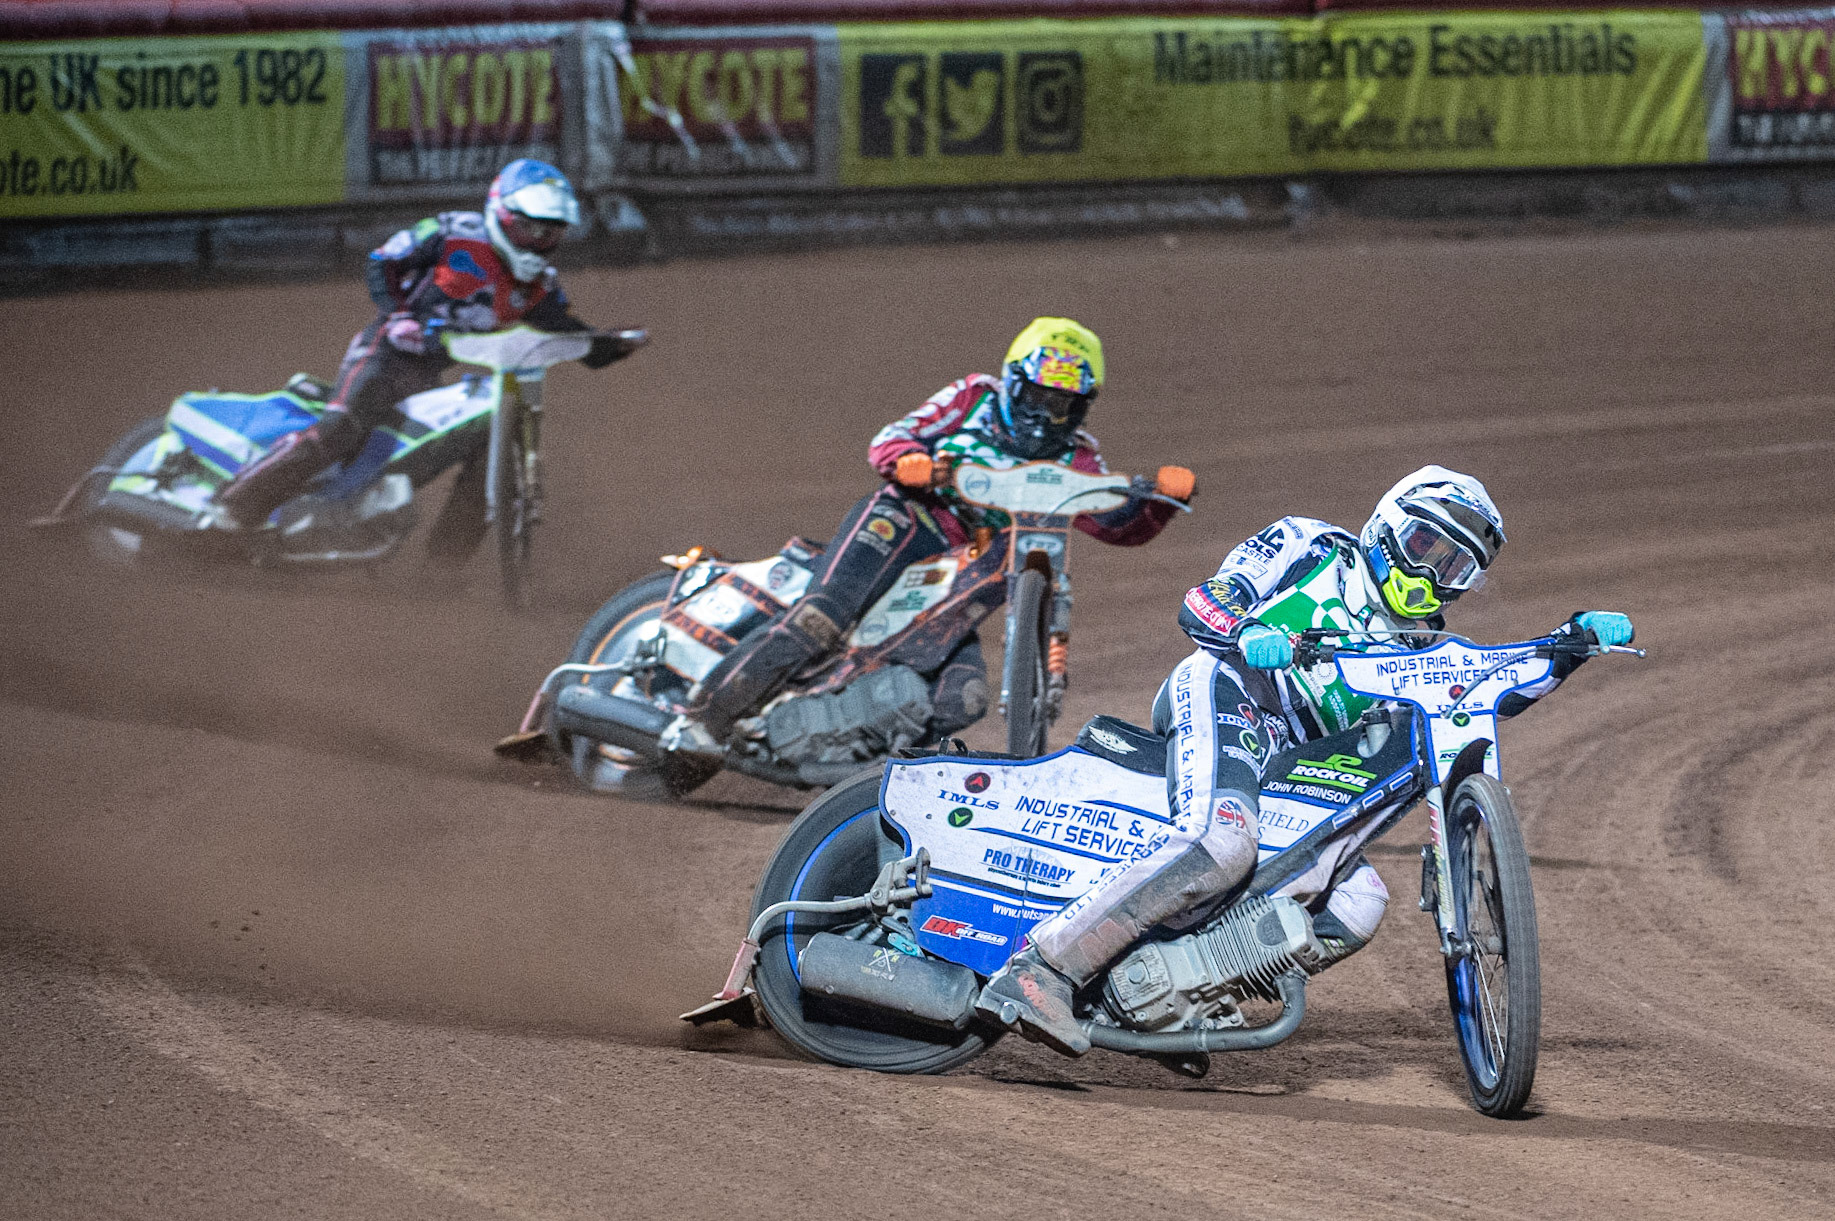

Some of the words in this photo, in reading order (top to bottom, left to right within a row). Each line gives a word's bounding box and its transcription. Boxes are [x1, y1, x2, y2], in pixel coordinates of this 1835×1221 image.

[1428, 23, 1638, 77] Essentials
[50, 52, 102, 112] UK
[117, 51, 219, 111] since
[233, 48, 328, 107] 1982
[377, 50, 552, 129] HYCOTE
[1376, 655, 1456, 677] INDUSTRIAL
[1462, 654, 1474, 666] &
[1391, 673, 1418, 690] LIFT
[1423, 669, 1489, 685] SERVICE
[1496, 669, 1518, 681] LTD
[1291, 765, 1340, 780] ROCK
[1338, 773, 1371, 788] OIL
[937, 789, 1000, 811] IMLS
[1263, 781, 1293, 793] JOHN
[1292, 784, 1352, 804] ROBINSON
[1014, 795, 1120, 832] INDUSTRIAL
[1128, 819, 1145, 839] &
[1020, 818, 1063, 841] LIFT
[983, 848, 1012, 868] PRO
[1013, 856, 1076, 882] THERAPY
